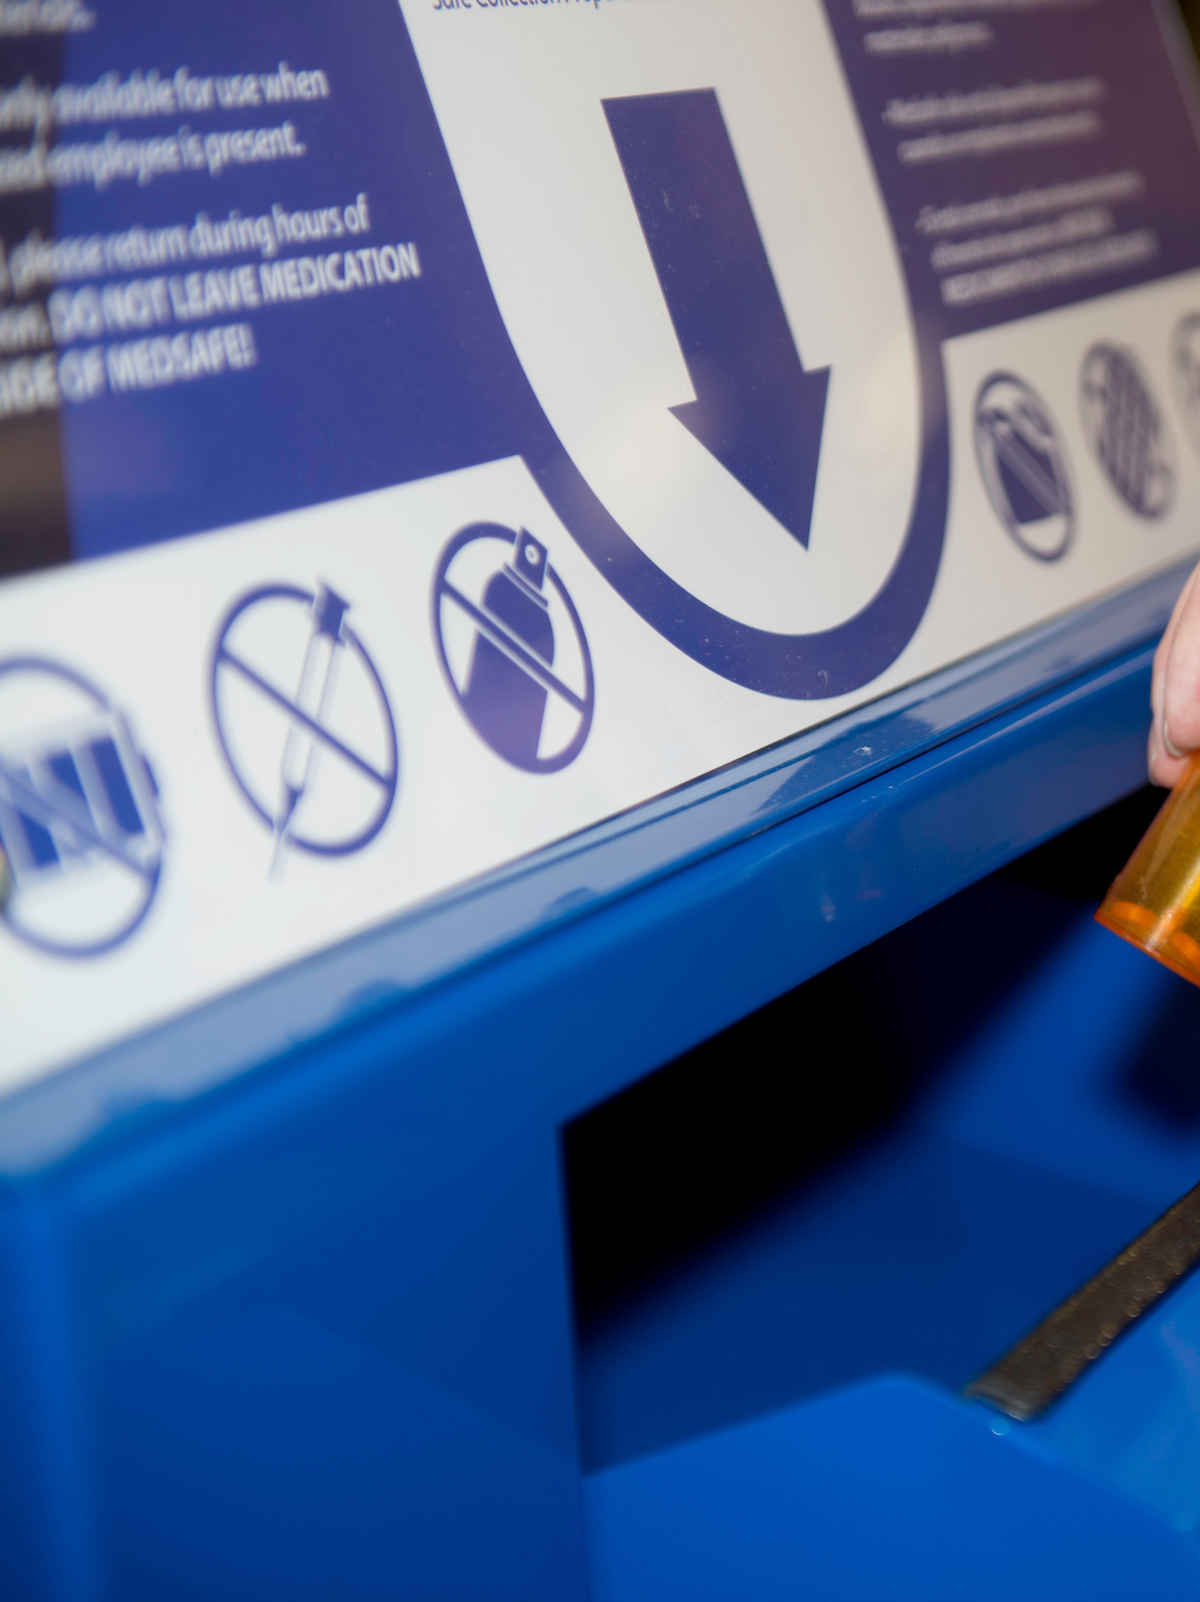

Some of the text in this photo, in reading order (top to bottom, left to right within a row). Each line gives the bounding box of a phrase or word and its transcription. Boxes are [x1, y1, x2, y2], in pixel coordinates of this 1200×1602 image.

[52, 68, 174, 125] available
[173, 65, 214, 112] for
[215, 73, 260, 109] use
[260, 61, 329, 102] when
[47, 128, 181, 191] employee
[178, 123, 204, 171] is
[203, 119, 307, 177] present.
[103, 222, 190, 273] return
[188, 208, 278, 259] during
[271, 201, 345, 244] hours
[342, 191, 370, 234] of
[48, 284, 103, 344] DO
[100, 274, 171, 334] NOT
[168, 262, 260, 322] LEAVE
[258, 240, 421, 303] MEDICATION
[57, 345, 104, 404] OF
[105, 321, 258, 396] MEDSAFE!
